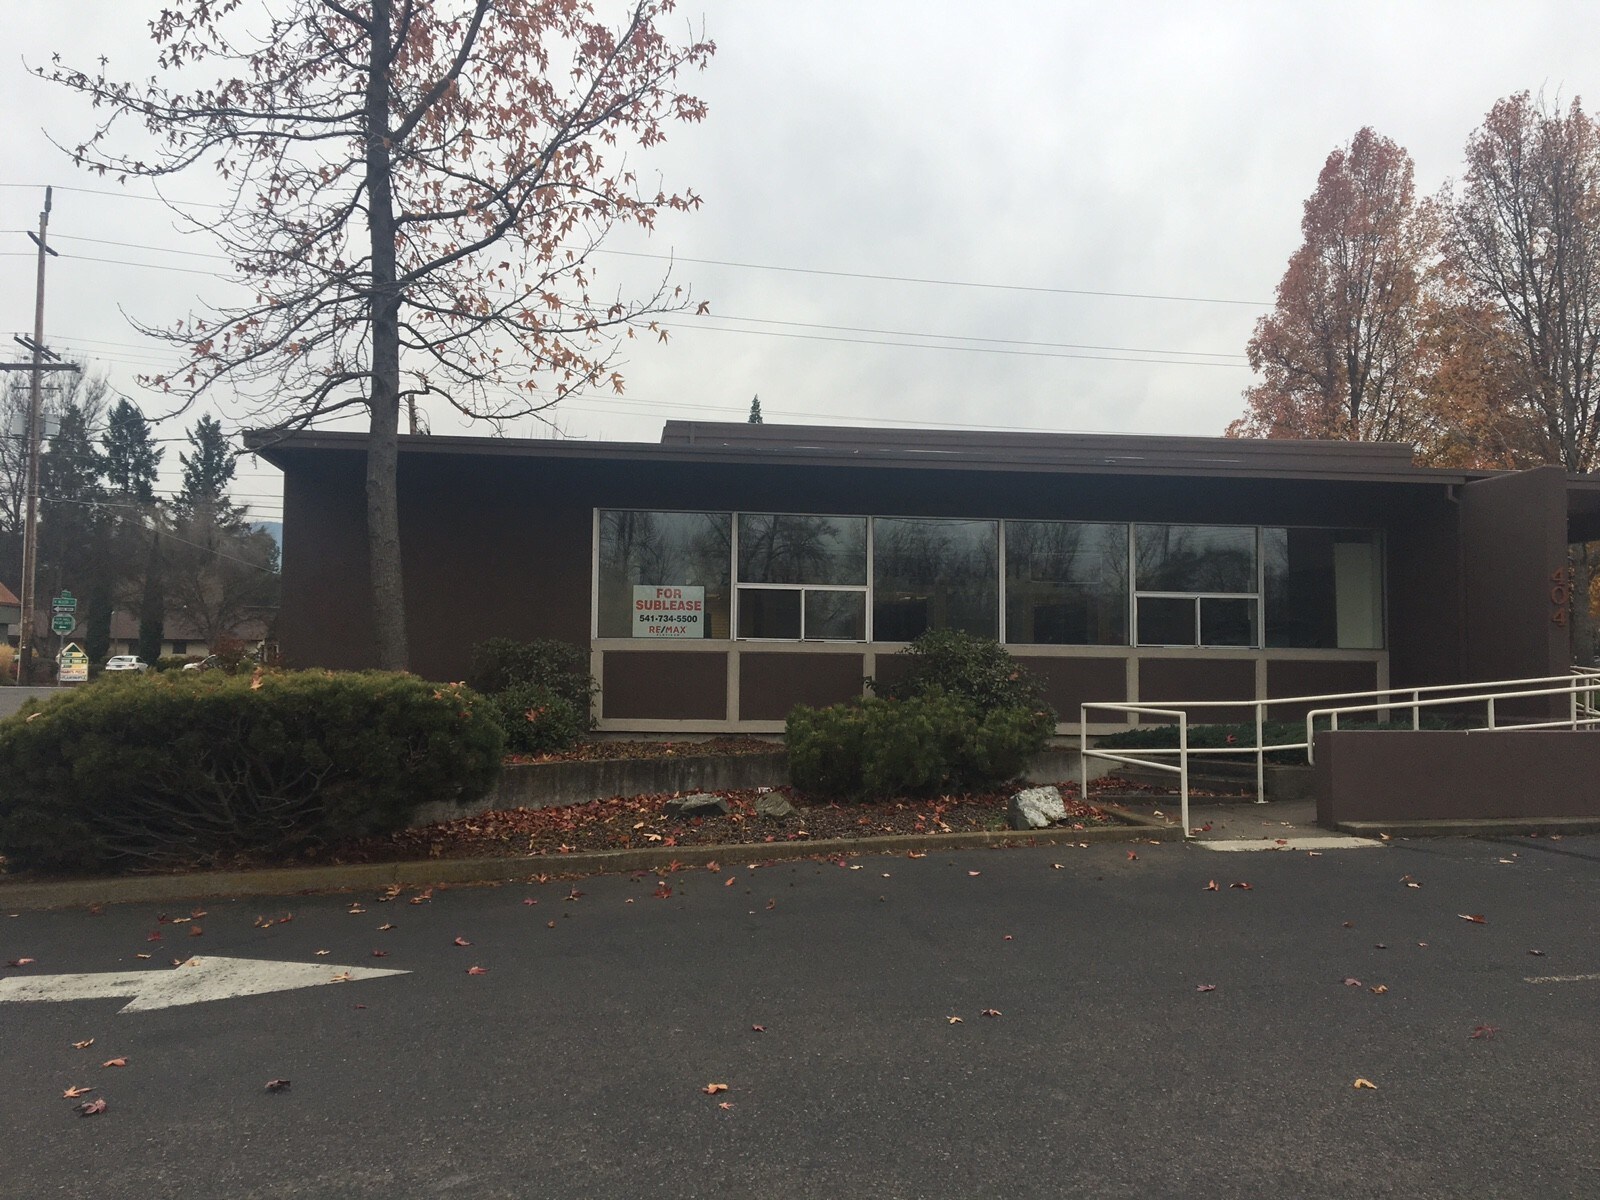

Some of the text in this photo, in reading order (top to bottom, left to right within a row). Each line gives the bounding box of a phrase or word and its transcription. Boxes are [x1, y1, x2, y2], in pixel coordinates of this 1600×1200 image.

[656, 588, 682, 599] FOR
[1551, 566, 1569, 628] 404
[635, 600, 702, 611] SUBLEASE
[639, 614, 698, 623] 541-734-5500
[648, 625, 687, 634] RE/MAX
